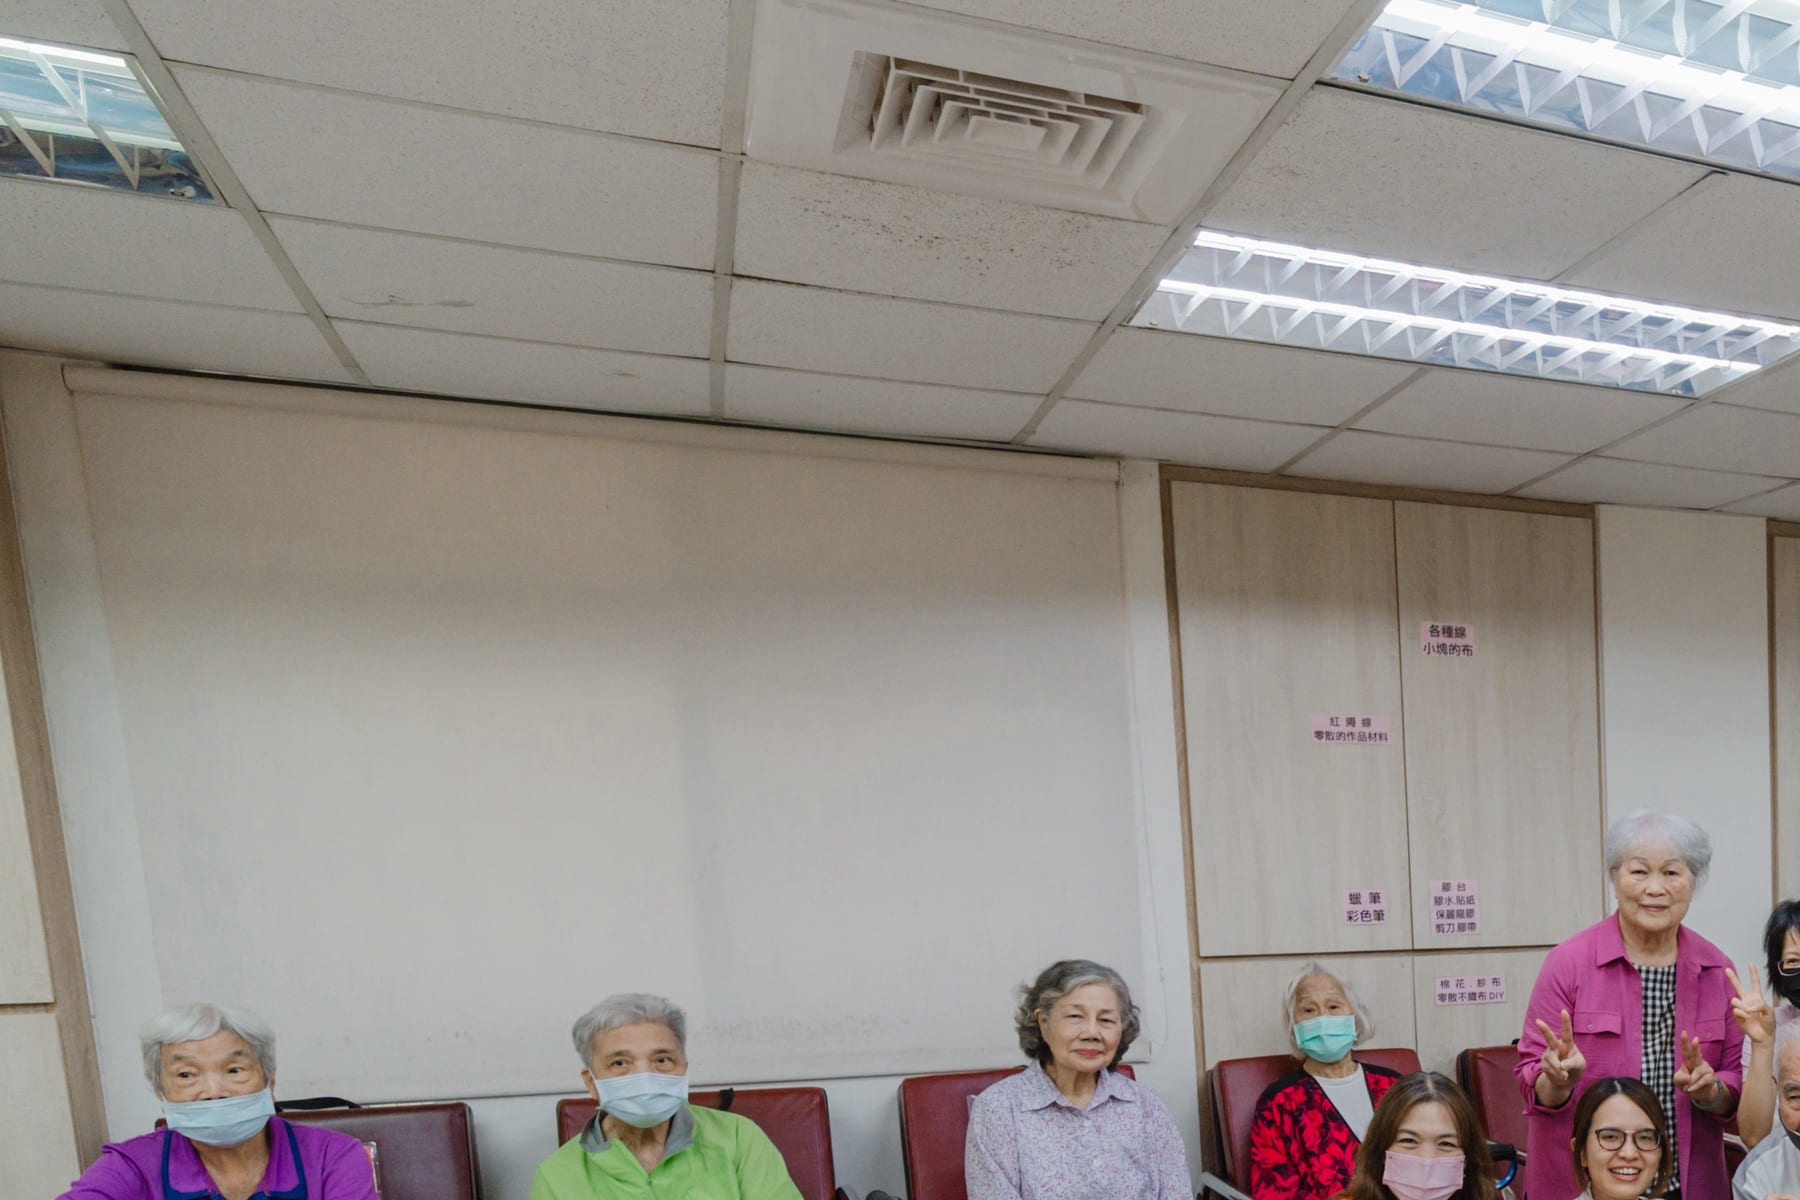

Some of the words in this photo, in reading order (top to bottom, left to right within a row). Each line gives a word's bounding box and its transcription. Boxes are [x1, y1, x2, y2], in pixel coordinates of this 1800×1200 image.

[1429, 624, 1466, 639] 各種線
[1423, 642, 1473, 656] 小塊的布
[1314, 730, 1388, 743] 零散的作品材料
[1349, 892, 1381, 905] 蠟筆
[1346, 909, 1385, 922] 彩色筆
[1436, 909, 1475, 919] 保麗龍膠
[1489, 992, 1504, 1000] DIY
